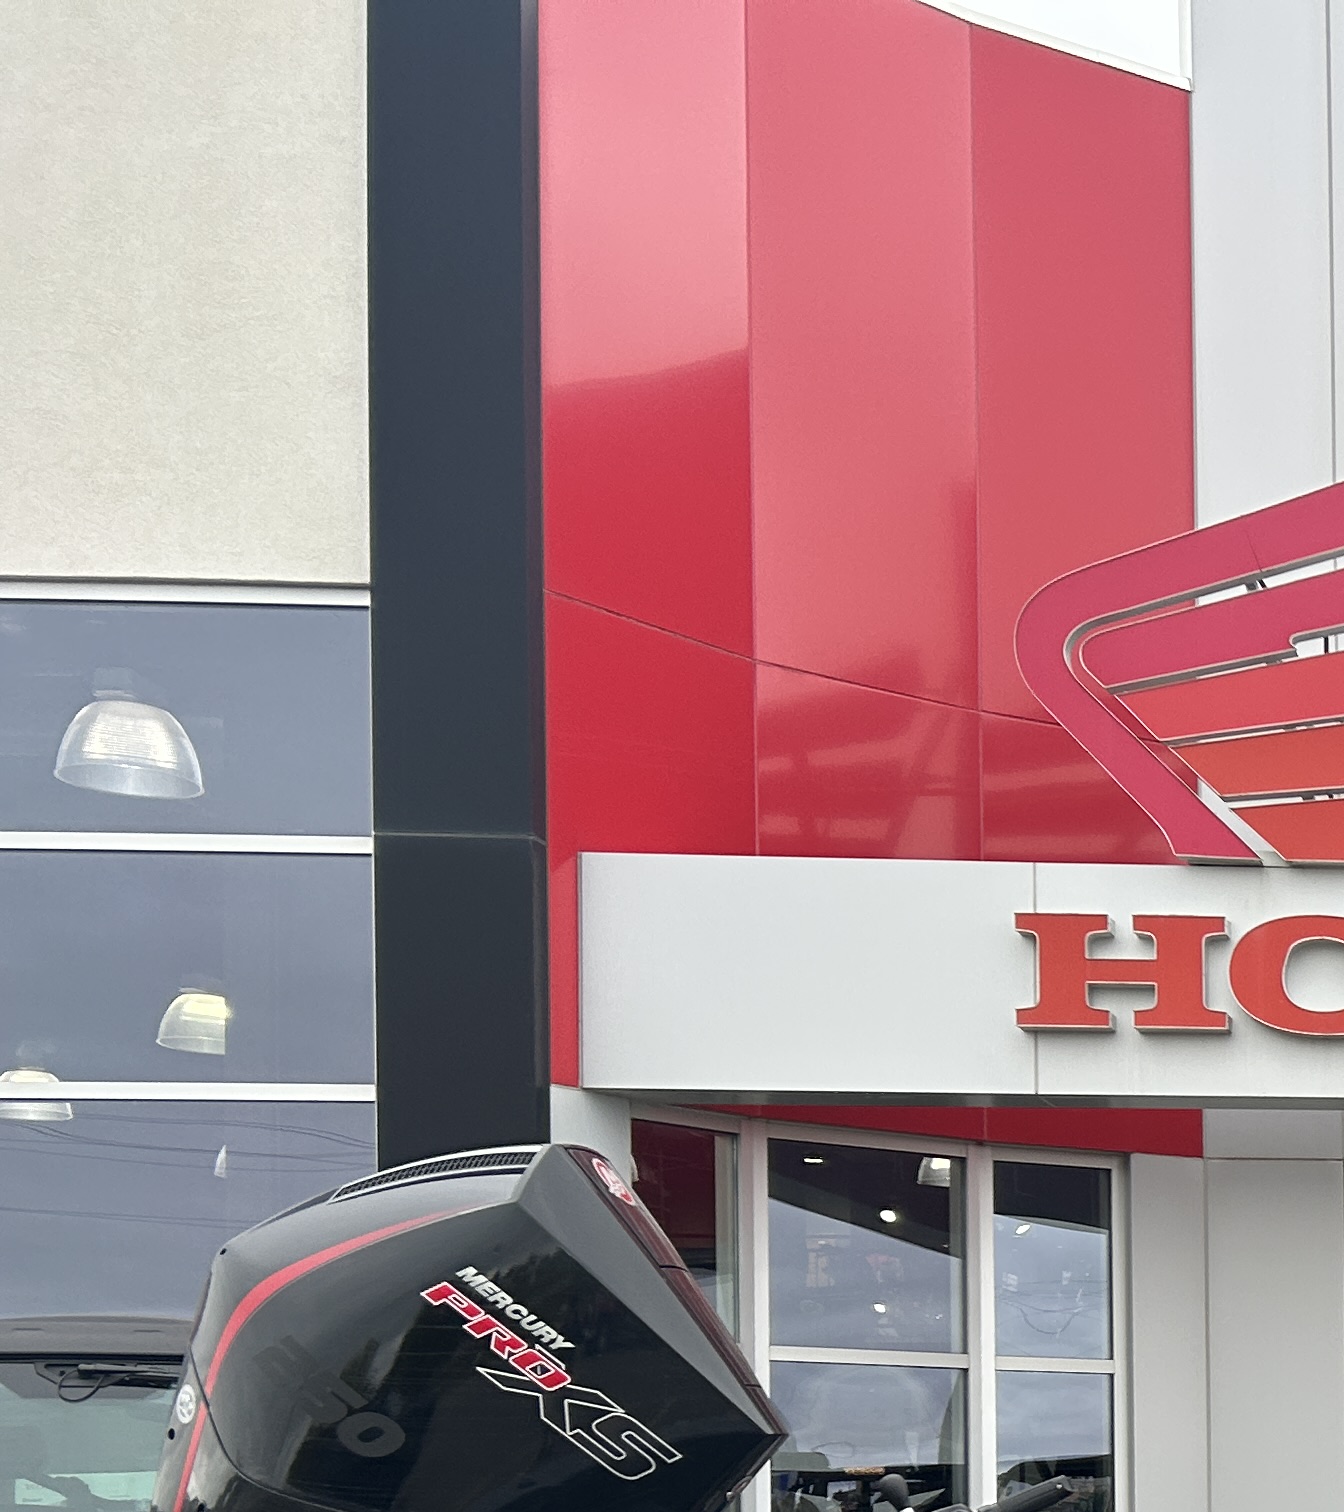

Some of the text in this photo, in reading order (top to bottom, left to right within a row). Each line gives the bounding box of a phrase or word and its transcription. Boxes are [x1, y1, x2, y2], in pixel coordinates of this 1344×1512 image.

[419, 1281, 572, 1391] PRO
[455, 1265, 576, 1350] MERCURY
[475, 1343, 683, 1480] XS
